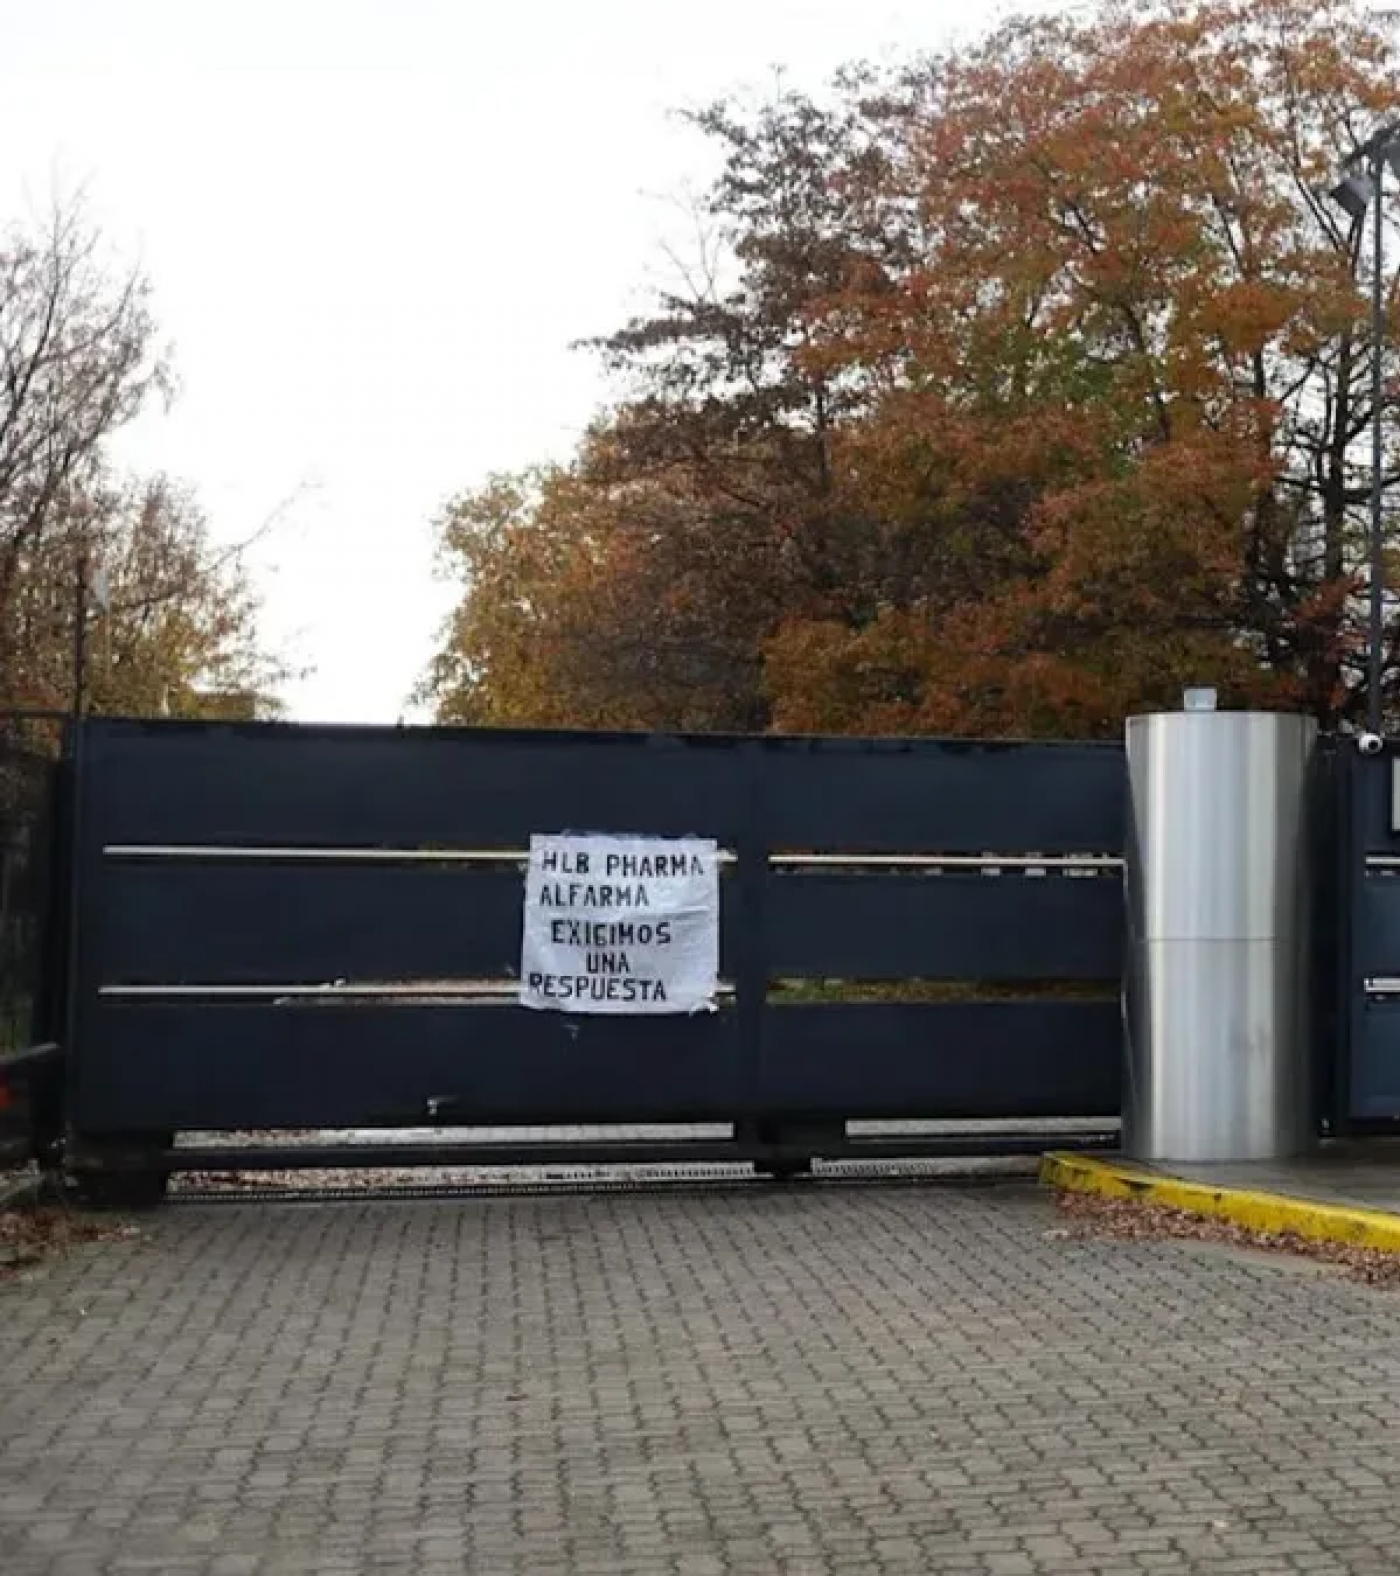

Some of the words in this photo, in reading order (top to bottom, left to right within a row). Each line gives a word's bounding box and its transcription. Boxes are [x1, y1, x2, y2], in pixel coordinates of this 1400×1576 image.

[542, 851, 589, 873] HLB
[606, 854, 704, 877] PHARMA
[540, 884, 649, 906] ALFARMA
[551, 919, 671, 946] EXIGIMOS
[586, 952, 630, 973] UNA
[528, 972, 667, 1002] RESPUESTA
